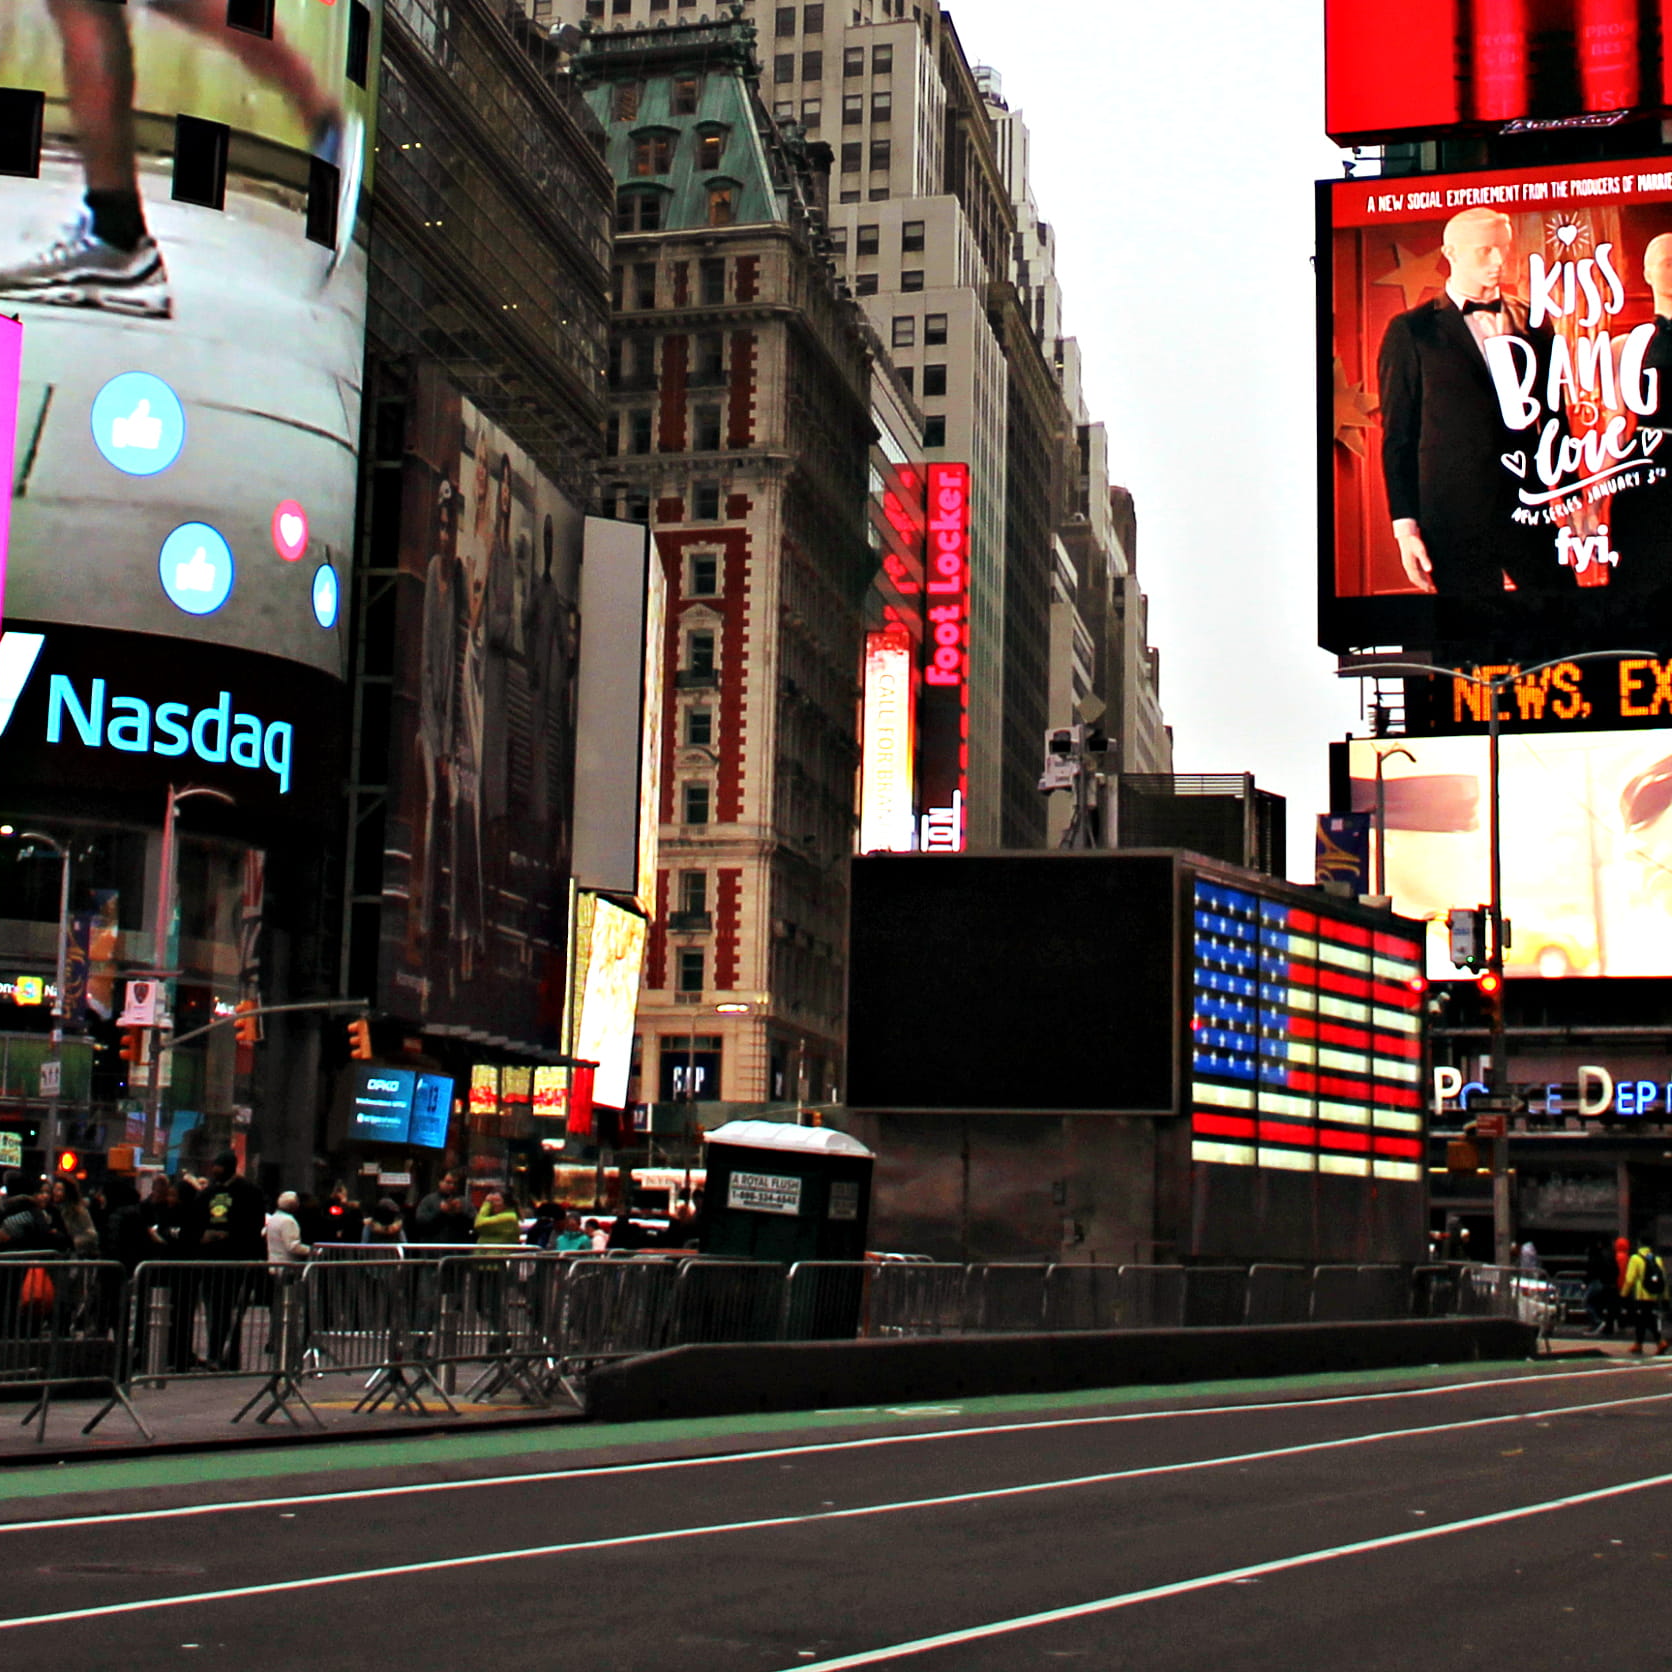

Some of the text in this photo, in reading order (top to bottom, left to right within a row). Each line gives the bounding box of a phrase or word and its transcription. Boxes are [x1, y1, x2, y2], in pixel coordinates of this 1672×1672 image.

[1378, 194, 1404, 212] NEW
[1407, 191, 1443, 210] SOCIAL
[1522, 182, 1548, 201] FROM
[1550, 180, 1568, 198] THE
[1542, 494, 1583, 524] SERIES
[1587, 470, 1641, 504] JANUARY
[925, 470, 962, 687] Foot Locker
[45, 673, 293, 793] Nasdaq
[741, 1175, 769, 1188] ROYAL
[771, 1176, 800, 1189] FLUSH
